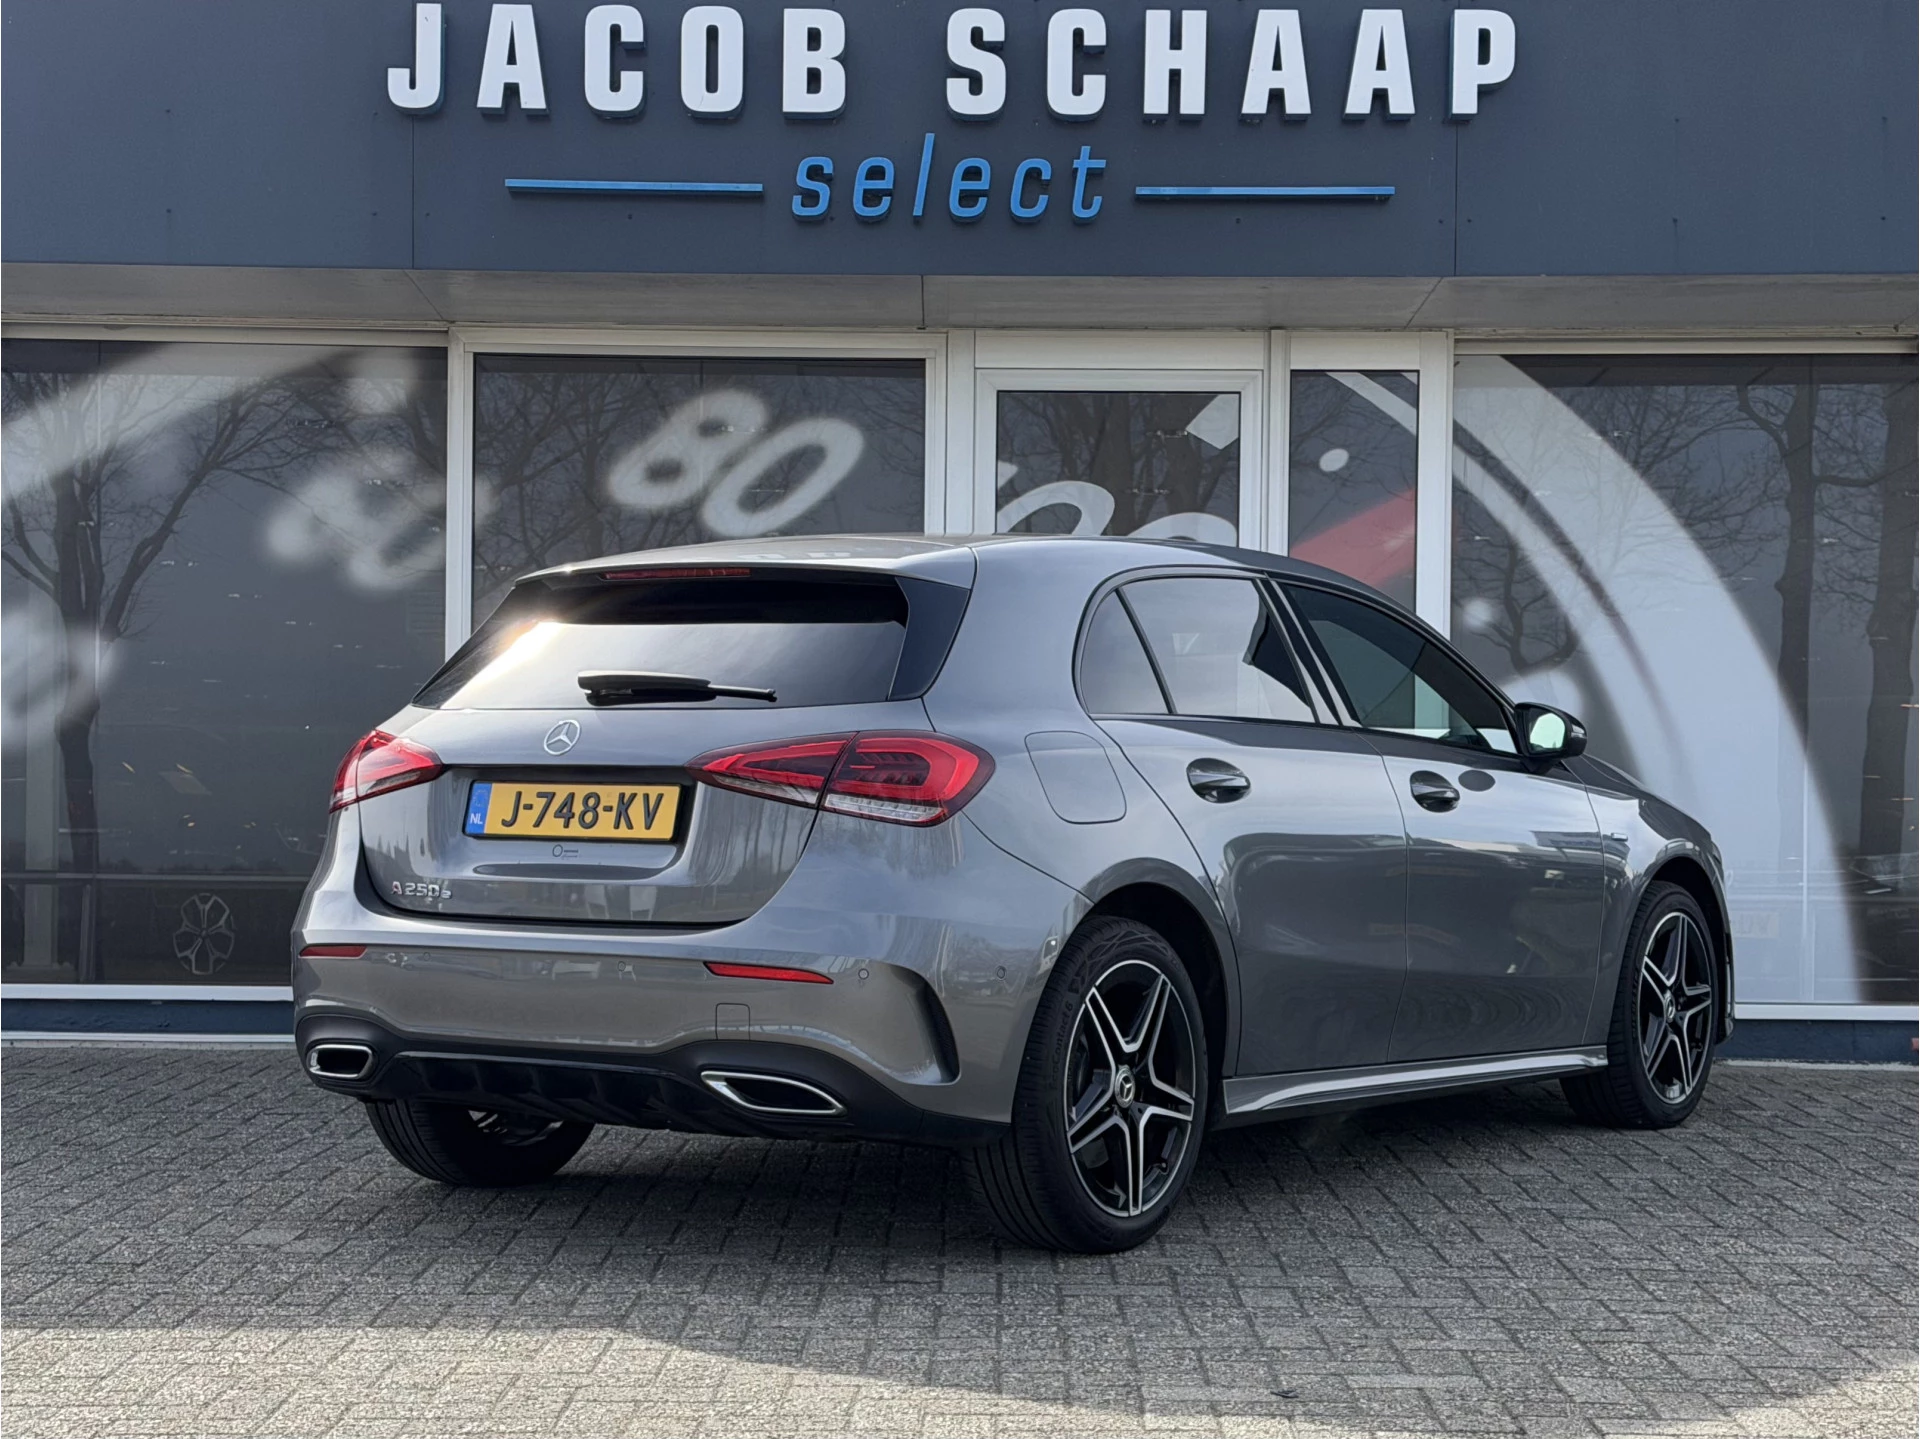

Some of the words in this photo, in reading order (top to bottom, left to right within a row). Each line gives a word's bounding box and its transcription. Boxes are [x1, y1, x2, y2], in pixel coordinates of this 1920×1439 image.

[387, 2, 848, 116] JACOB
[946, 8, 1516, 118] SCHAAP
[792, 133, 1107, 220] select
[469, 812, 483, 825] NL
[501, 790, 665, 831] J-748-KV
[391, 880, 403, 895] A
